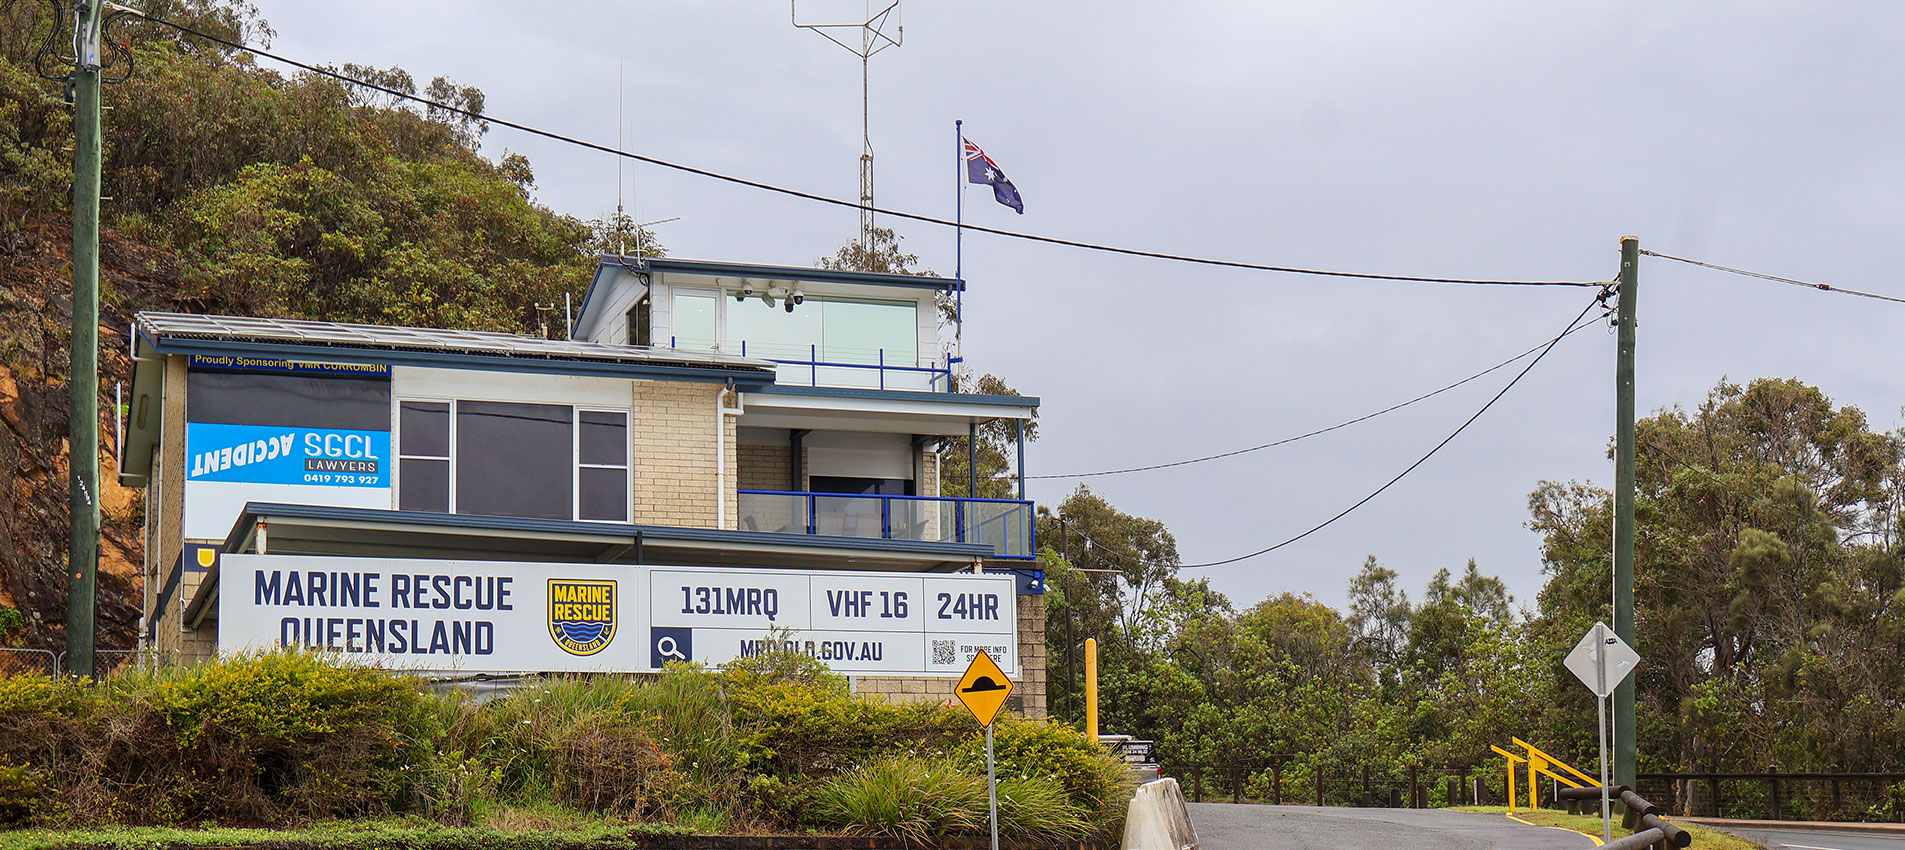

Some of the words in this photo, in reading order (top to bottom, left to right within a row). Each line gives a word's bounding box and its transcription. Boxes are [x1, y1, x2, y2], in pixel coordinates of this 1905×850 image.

[195, 354, 233, 366] Proudly
[236, 356, 294, 369] Sponsoring
[323, 363, 387, 373] CURRUMBIN
[191, 433, 295, 477] ACCIDENT
[304, 433, 379, 459] SGCL
[308, 461, 376, 472] LAWYERS
[304, 474, 331, 483] 0419
[335, 474, 355, 483] 793
[358, 475, 379, 485] 927
[254, 569, 380, 608] MARINE
[391, 573, 513, 611] RESCUE
[554, 585, 611, 603] MARINE
[554, 603, 611, 621] RESCUE
[681, 586, 778, 621] 131MRQ
[826, 589, 873, 618] VHF
[880, 591, 908, 619] 16
[937, 592, 999, 621] 24HR
[280, 617, 494, 655] QUEENSLAND
[564, 638, 601, 651] QUEENSLAND
[961, 645, 973, 653] FOR
[993, 646, 1007, 654] INFO
